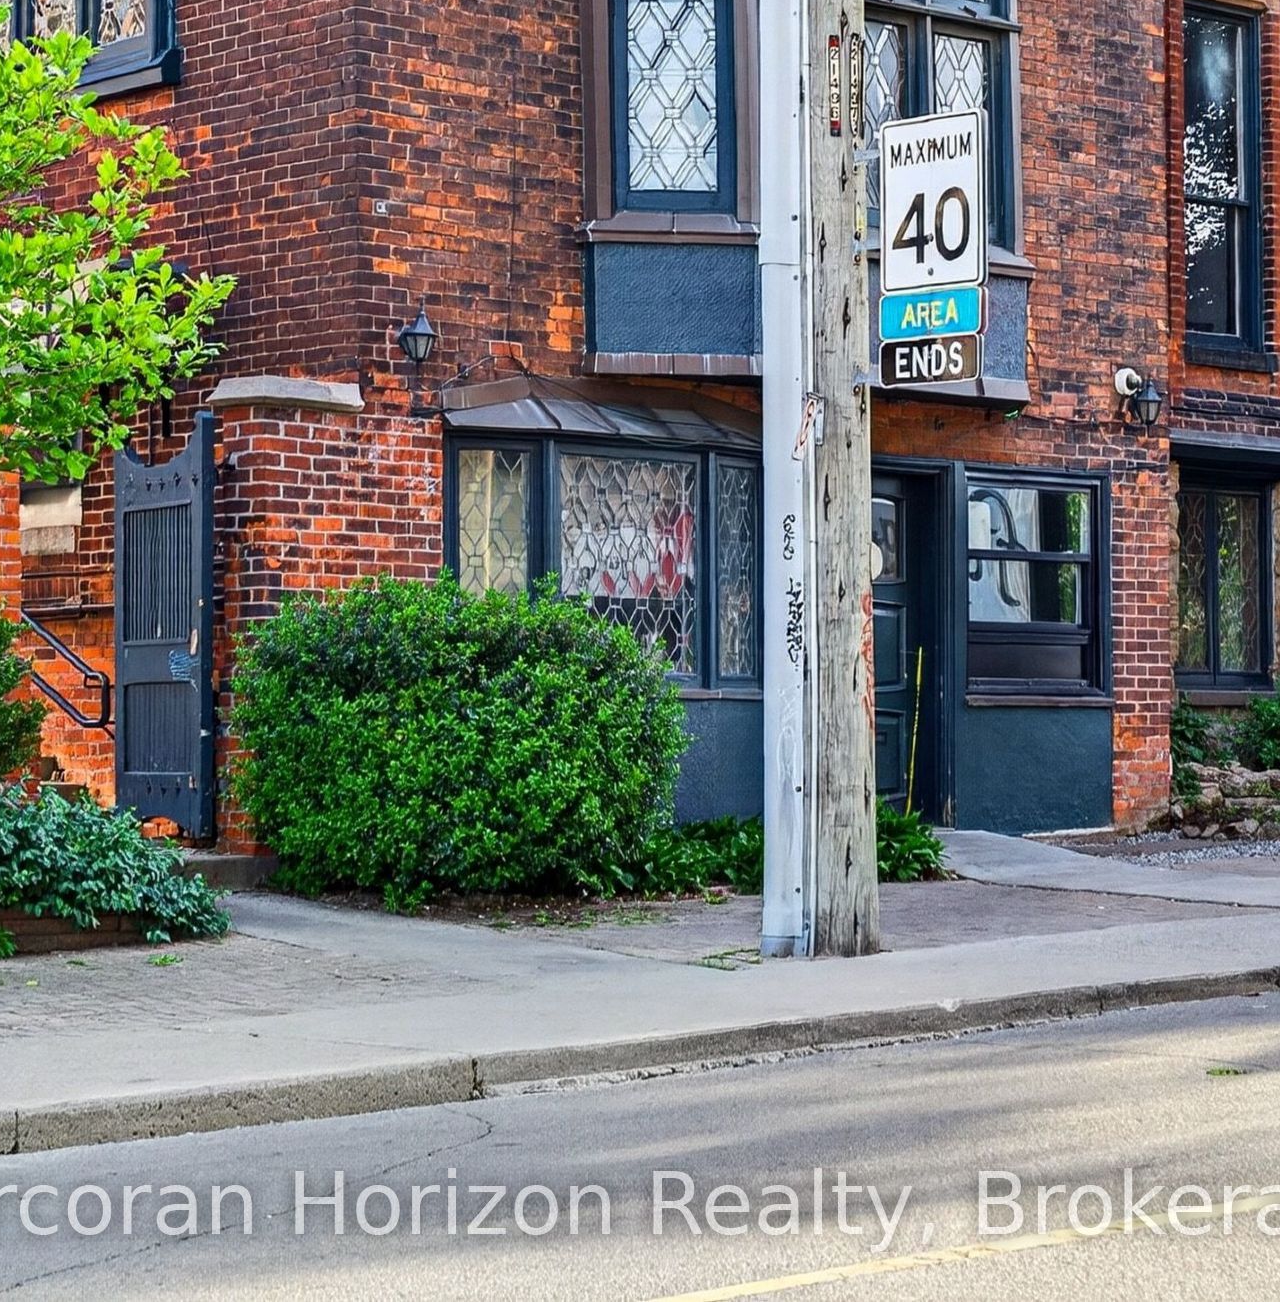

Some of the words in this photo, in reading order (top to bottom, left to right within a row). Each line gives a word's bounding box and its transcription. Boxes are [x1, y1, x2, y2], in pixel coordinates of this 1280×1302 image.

[890, 132, 972, 168] MAXIMUM
[892, 186, 970, 264] 40
[901, 297, 959, 330] AREA
[894, 341, 964, 379] ENDS
